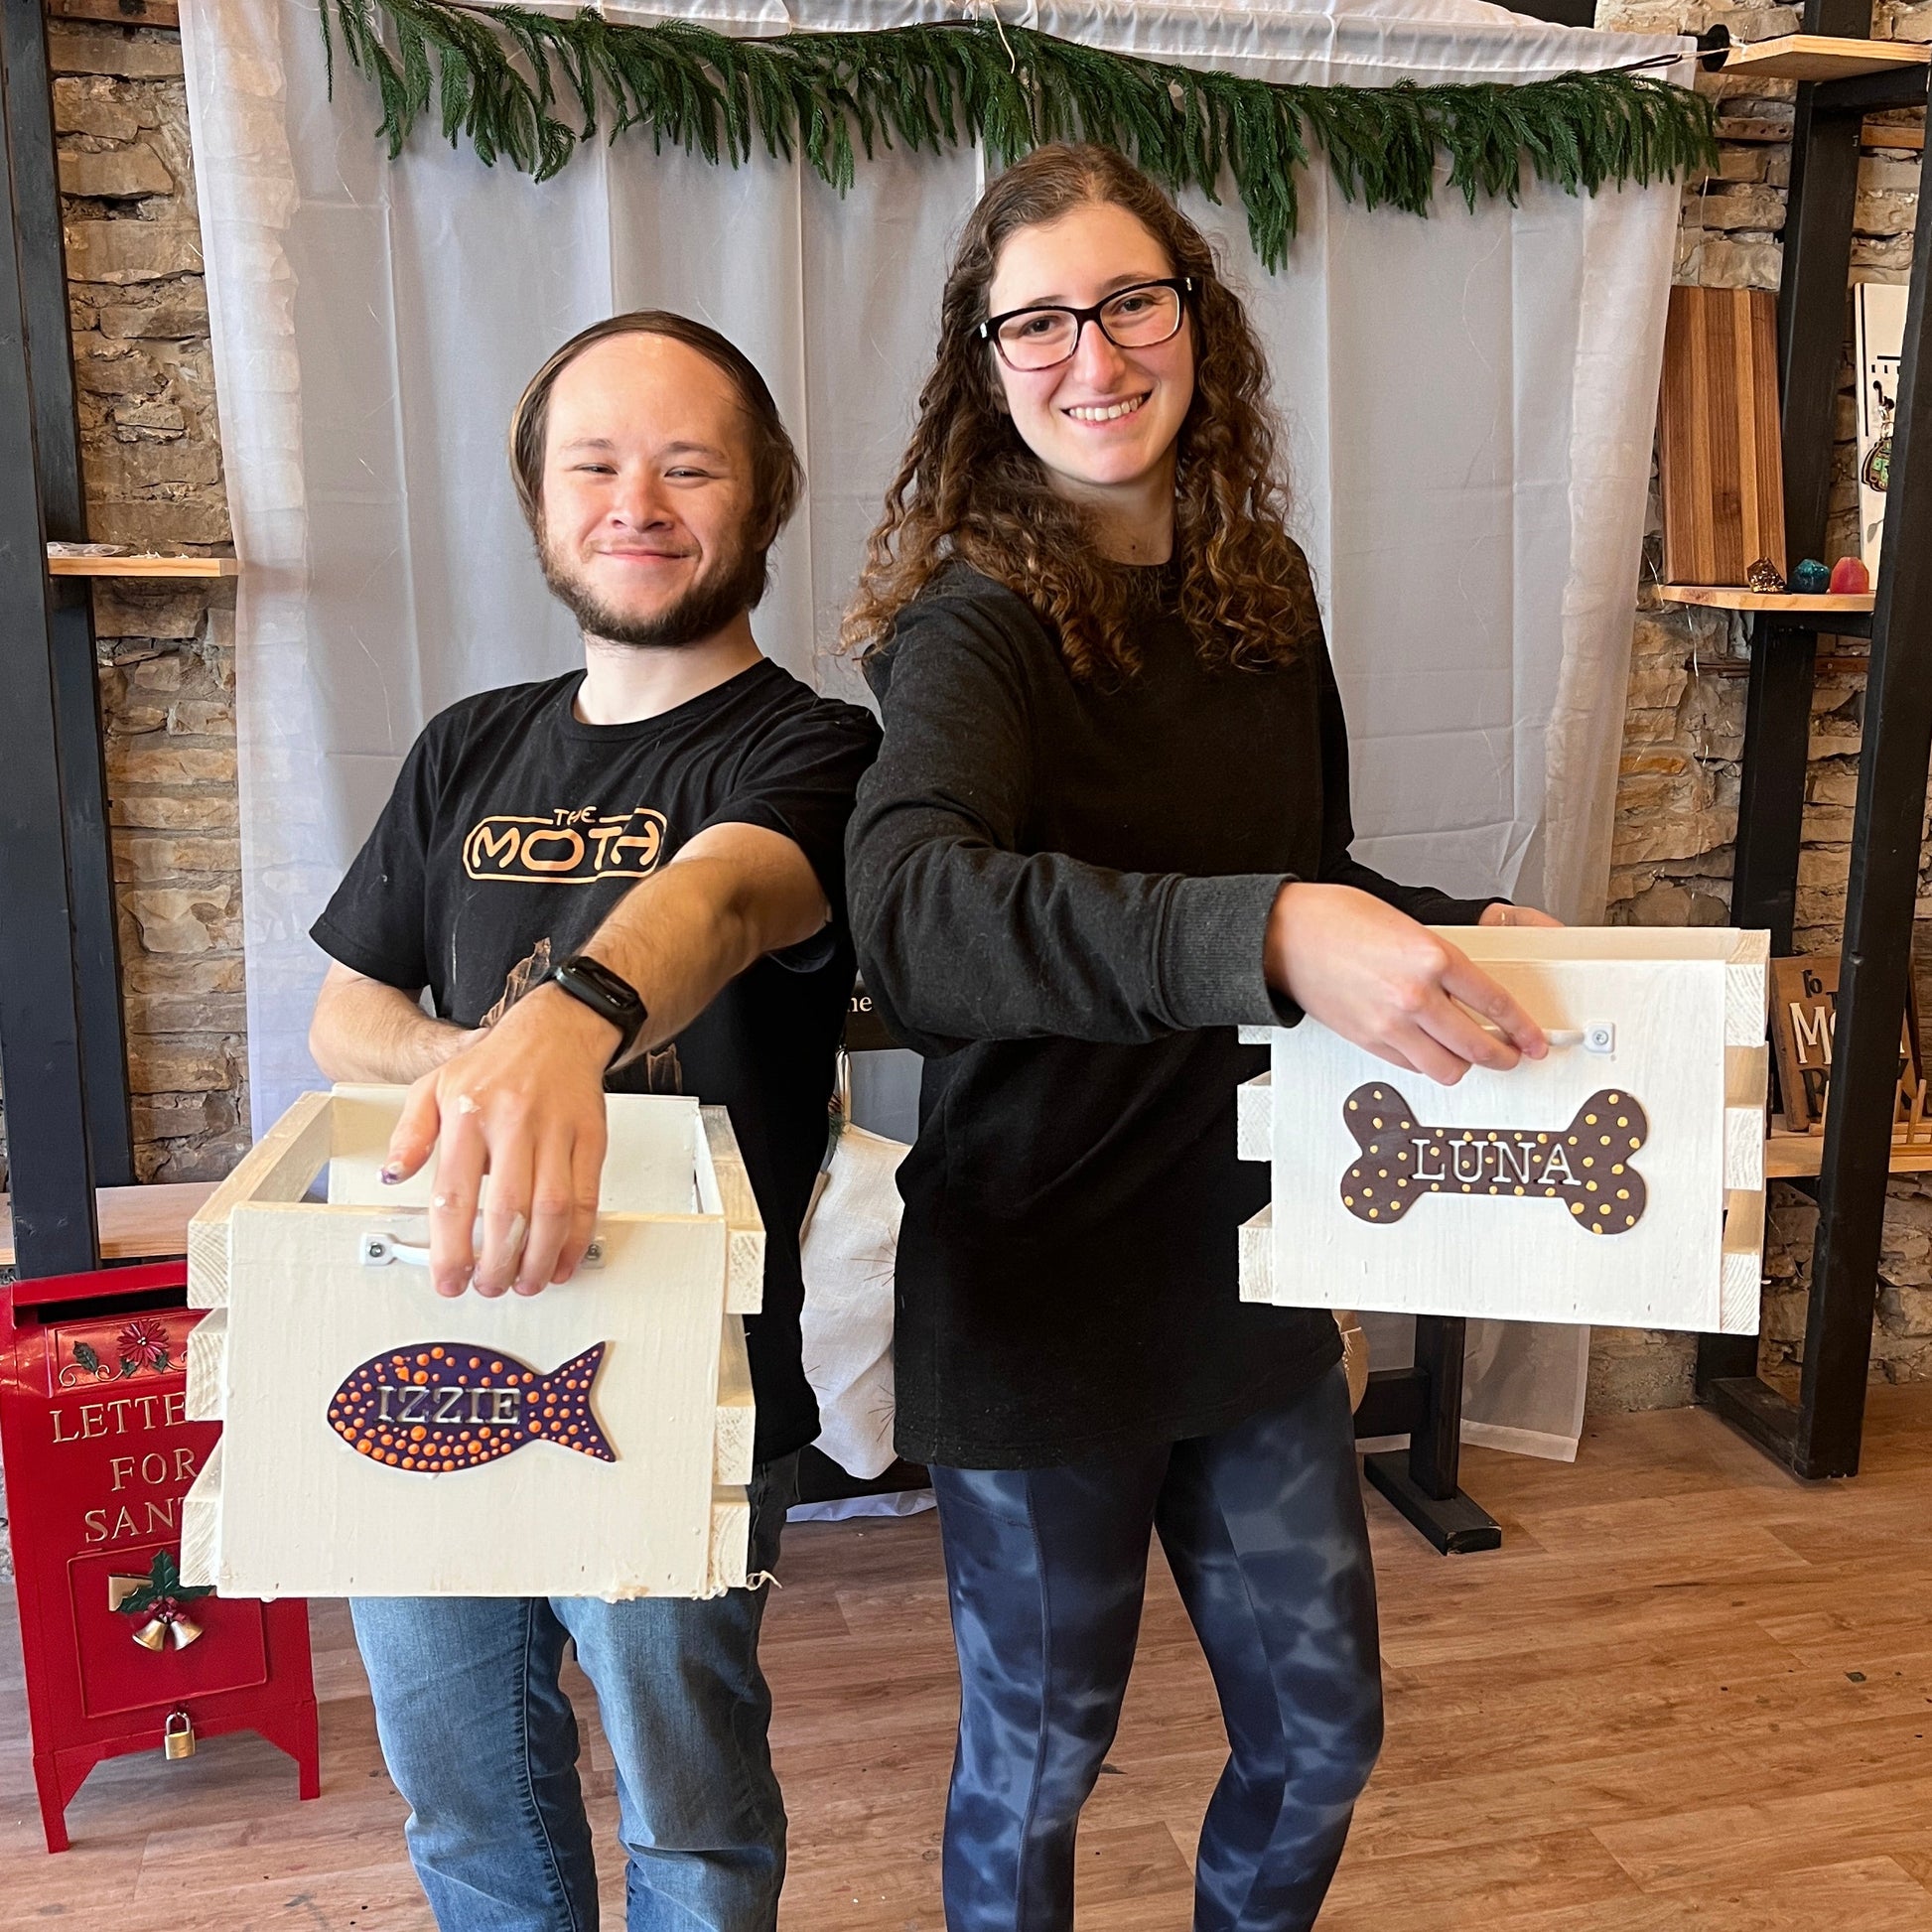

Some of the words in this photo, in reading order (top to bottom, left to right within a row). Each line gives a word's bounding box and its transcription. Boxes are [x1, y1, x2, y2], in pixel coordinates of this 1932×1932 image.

[553, 805, 598, 826] THE
[472, 820, 660, 872] MOTH
[1409, 1138, 1582, 1186] LUNA
[375, 1385, 521, 1426] IZZIE
[109, 1448, 199, 1492] FOR
[84, 1496, 186, 1544] SAN
